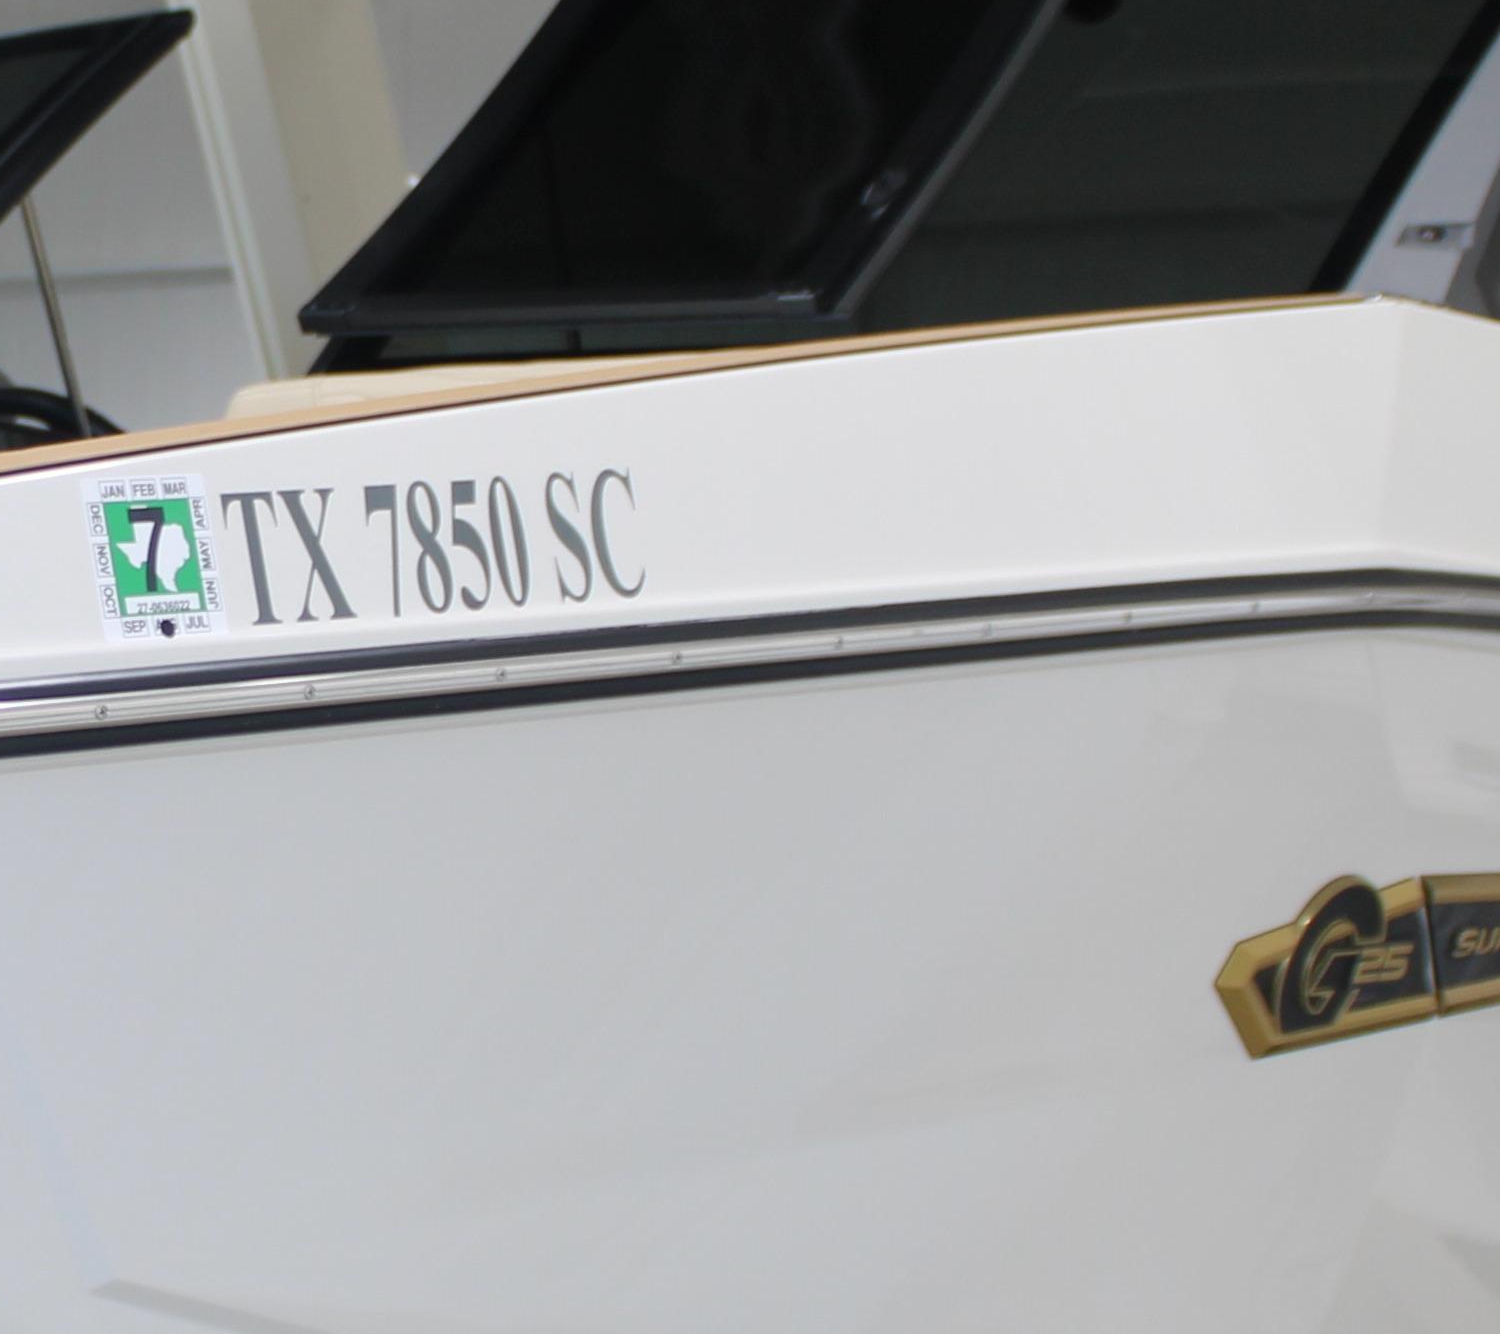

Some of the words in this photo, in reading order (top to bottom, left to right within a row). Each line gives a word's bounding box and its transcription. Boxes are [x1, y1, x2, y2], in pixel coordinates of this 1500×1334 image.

[101, 485, 125, 498] JAN
[132, 483, 156, 497] FEB
[162, 481, 187, 495] MAR
[90, 504, 104, 535] DEC
[192, 498, 206, 529] APR
[96, 545, 111, 576] NOV
[127, 506, 165, 593] 7
[199, 540, 213, 571] MAY
[220, 487, 358, 626] TX
[363, 475, 531, 618] 7850
[544, 468, 647, 605] SC
[103, 586, 118, 616] OCT
[205, 580, 219, 609] JUN
[123, 619, 147, 634] SEP
[186, 615, 209, 629] JUL
